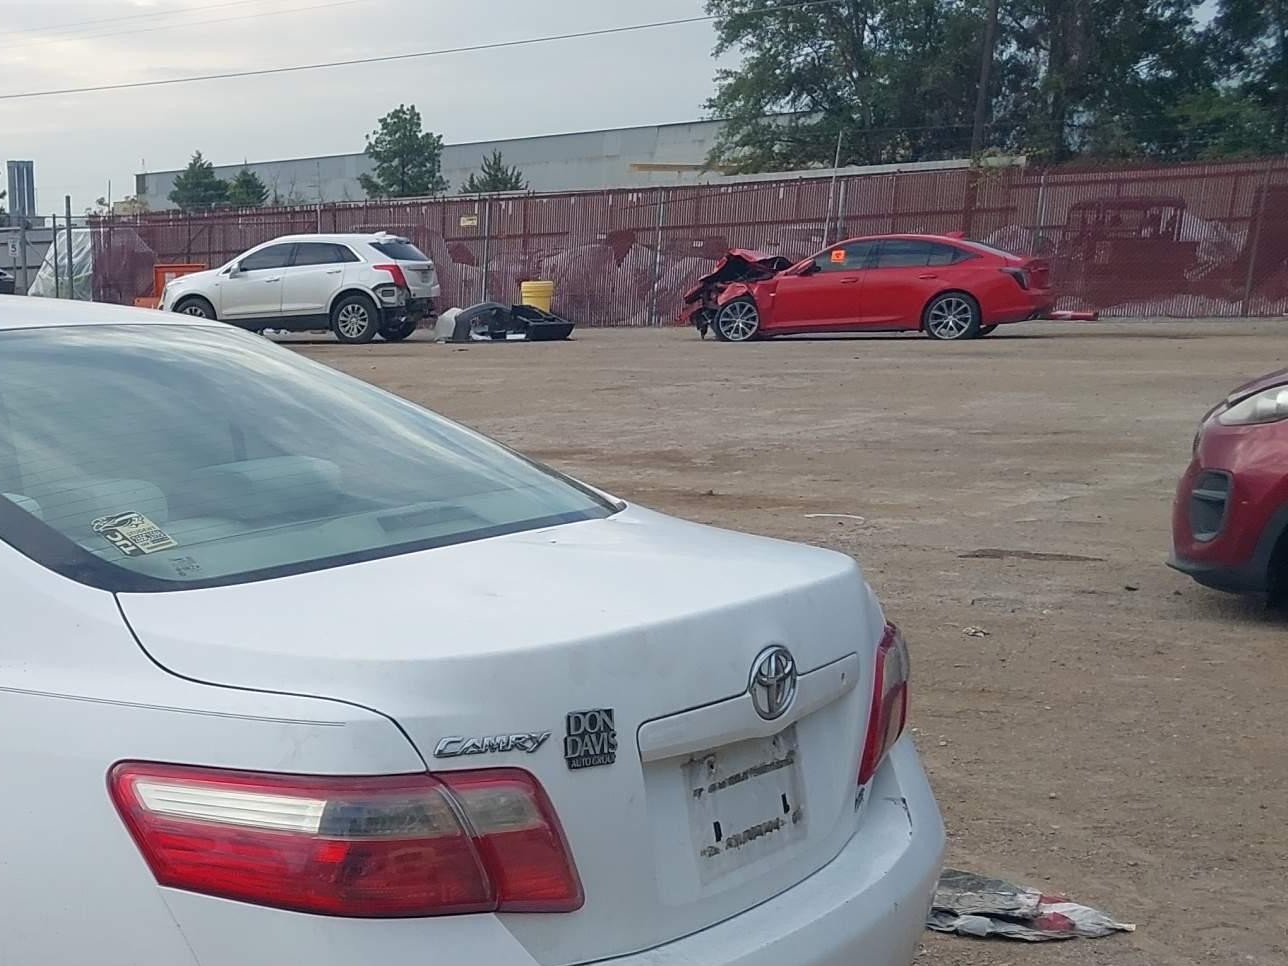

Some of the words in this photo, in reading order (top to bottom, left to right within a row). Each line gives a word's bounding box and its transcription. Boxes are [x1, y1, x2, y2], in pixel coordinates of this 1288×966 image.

[11, 244, 17, 253] 5
[567, 710, 615, 735] DON
[433, 730, 553, 758] CAMRY
[564, 731, 618, 758] DAVIS
[571, 757, 592, 768] AUTO
